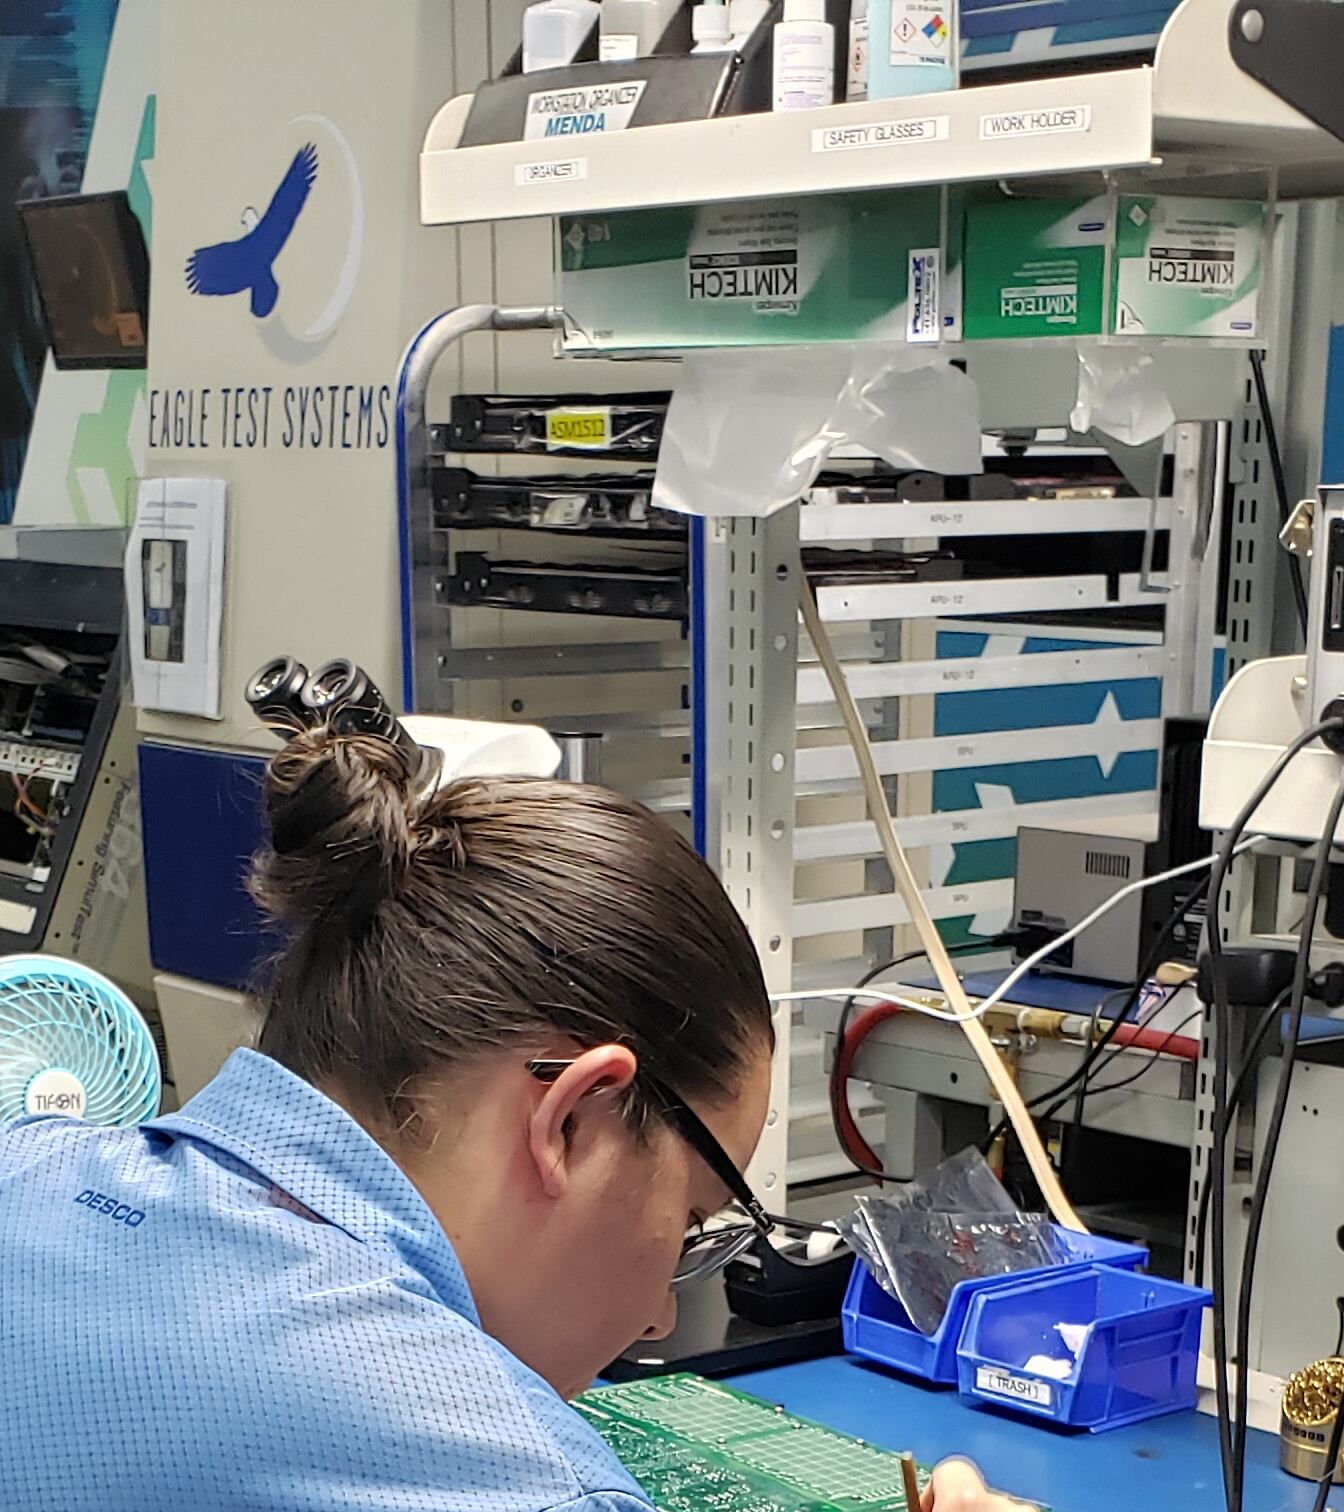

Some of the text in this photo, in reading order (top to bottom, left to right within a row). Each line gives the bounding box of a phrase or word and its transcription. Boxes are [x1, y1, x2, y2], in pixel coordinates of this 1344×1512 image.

[545, 113, 605, 137] MENDA
[991, 110, 1077, 133] WORK HOLDER
[829, 122, 924, 145] SAFETY GLASSES
[690, 267, 798, 299] KIMTECH
[1149, 261, 1235, 284] KIMTECH
[1001, 295, 1078, 317] KIMTECH
[149, 385, 391, 448] EAGLE TEST SYSTEMS
[35, 1093, 81, 1110] TIFON
[74, 1190, 146, 1228] DESCO
[996, 1375, 1031, 1396] TRASH
